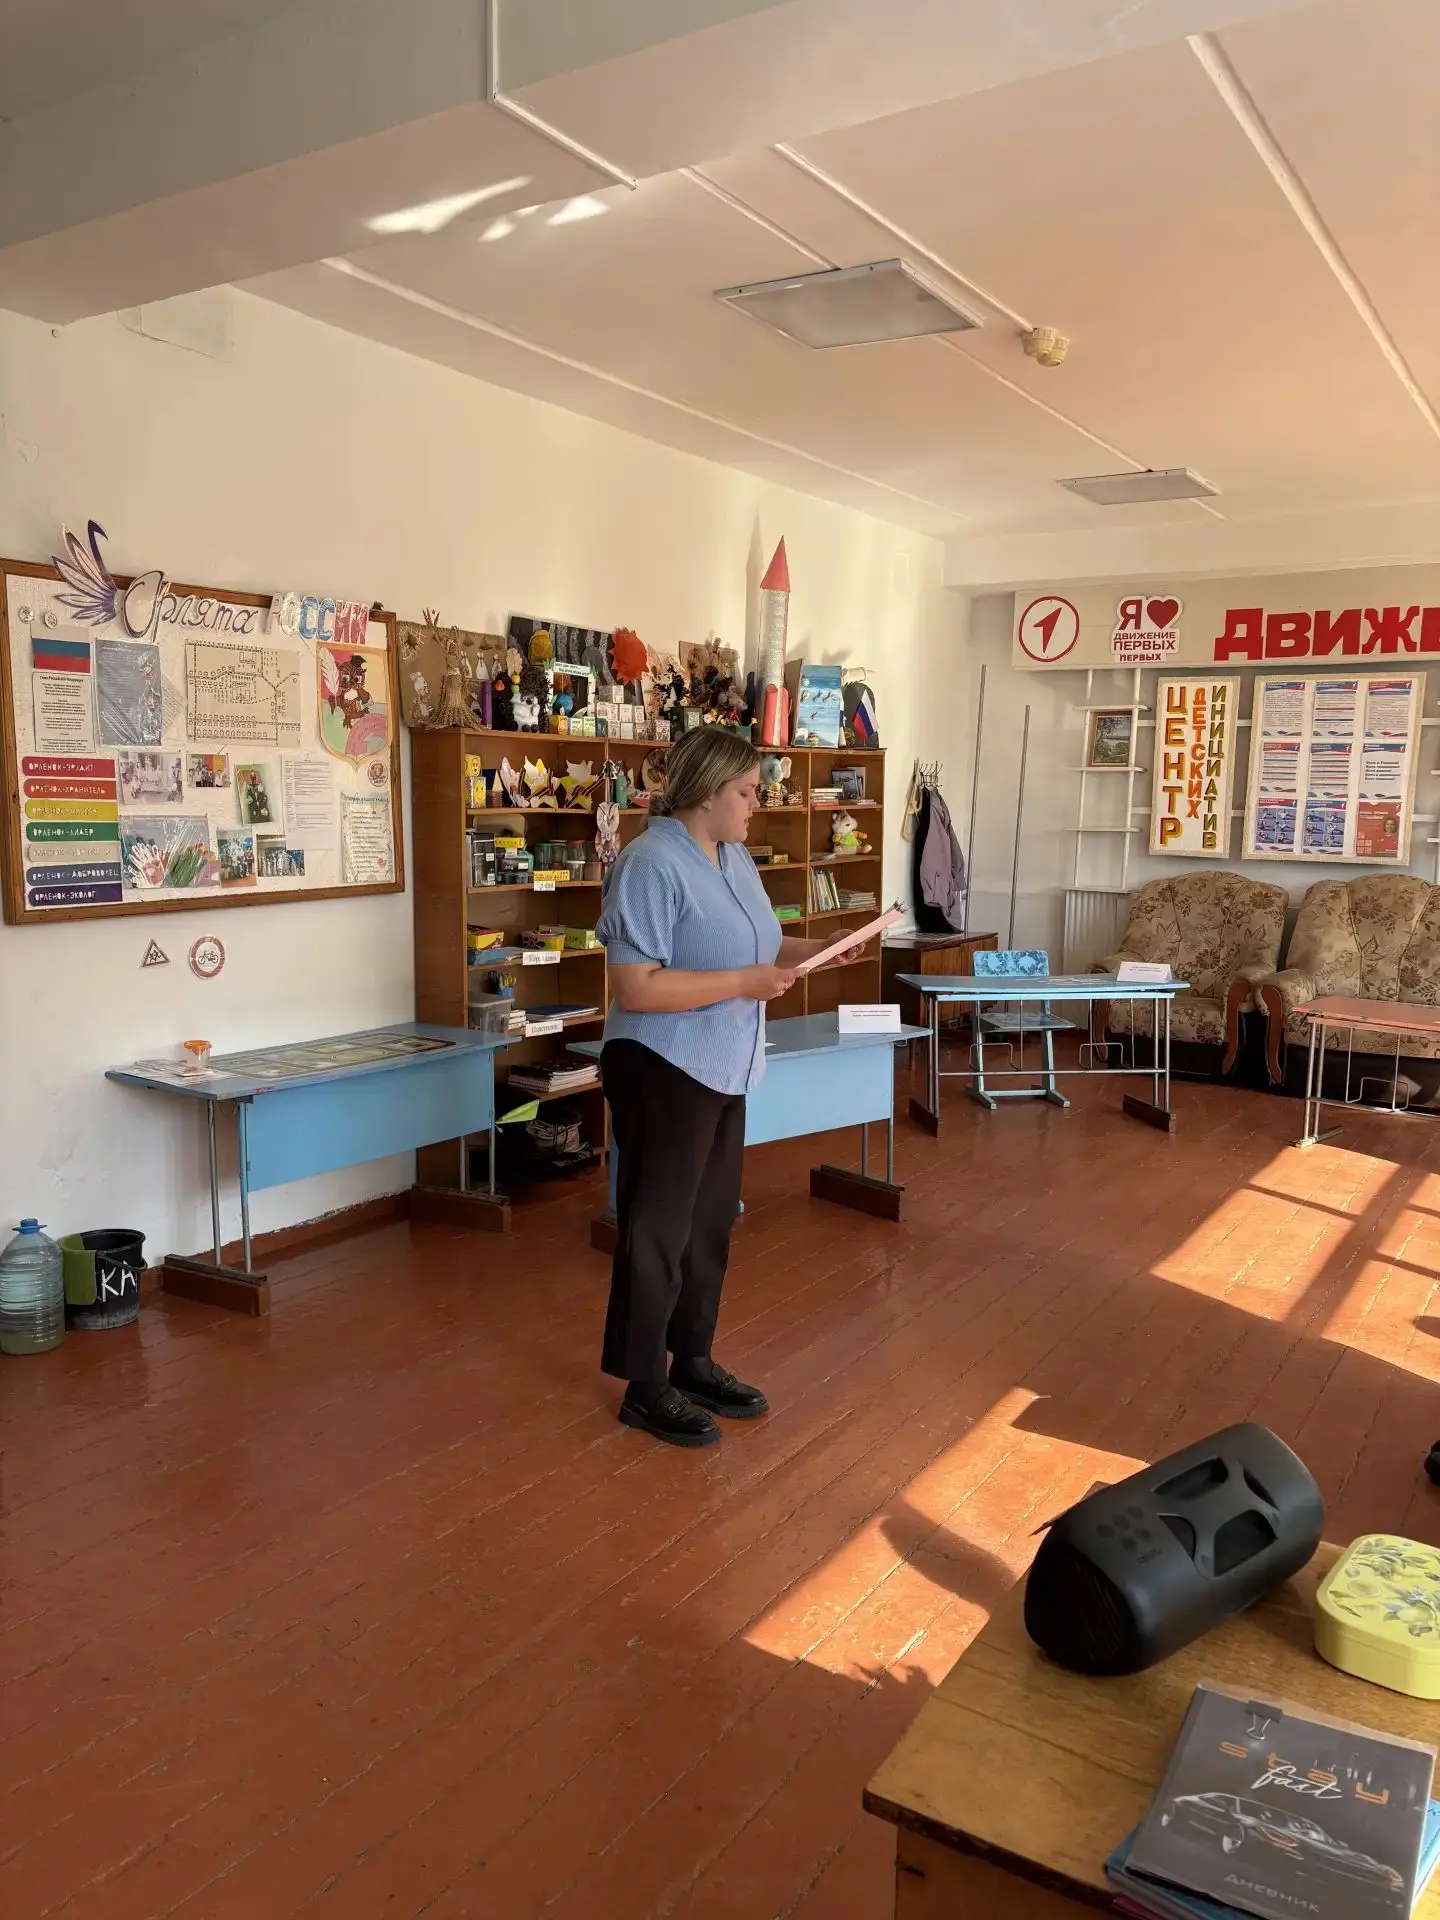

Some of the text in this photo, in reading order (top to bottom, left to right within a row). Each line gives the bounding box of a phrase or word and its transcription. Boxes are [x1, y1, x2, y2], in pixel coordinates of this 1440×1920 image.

[123, 569, 369, 645] Орлята РОССИИ
[1118, 599, 1143, 631] Я
[1113, 631, 1176, 641] ДВИЖЕНИЕ
[1113, 640, 1176, 651] ПЕРВЫХ
[1119, 653, 1162, 662] ПЕРВЫХ
[1160, 686, 1188, 847] ЦЕНТР
[1186, 687, 1207, 819] ДЕТСКИХ
[1202, 685, 1227, 849] ИНИЦИАТИВ
[1251, 1765, 1343, 1799] fast
